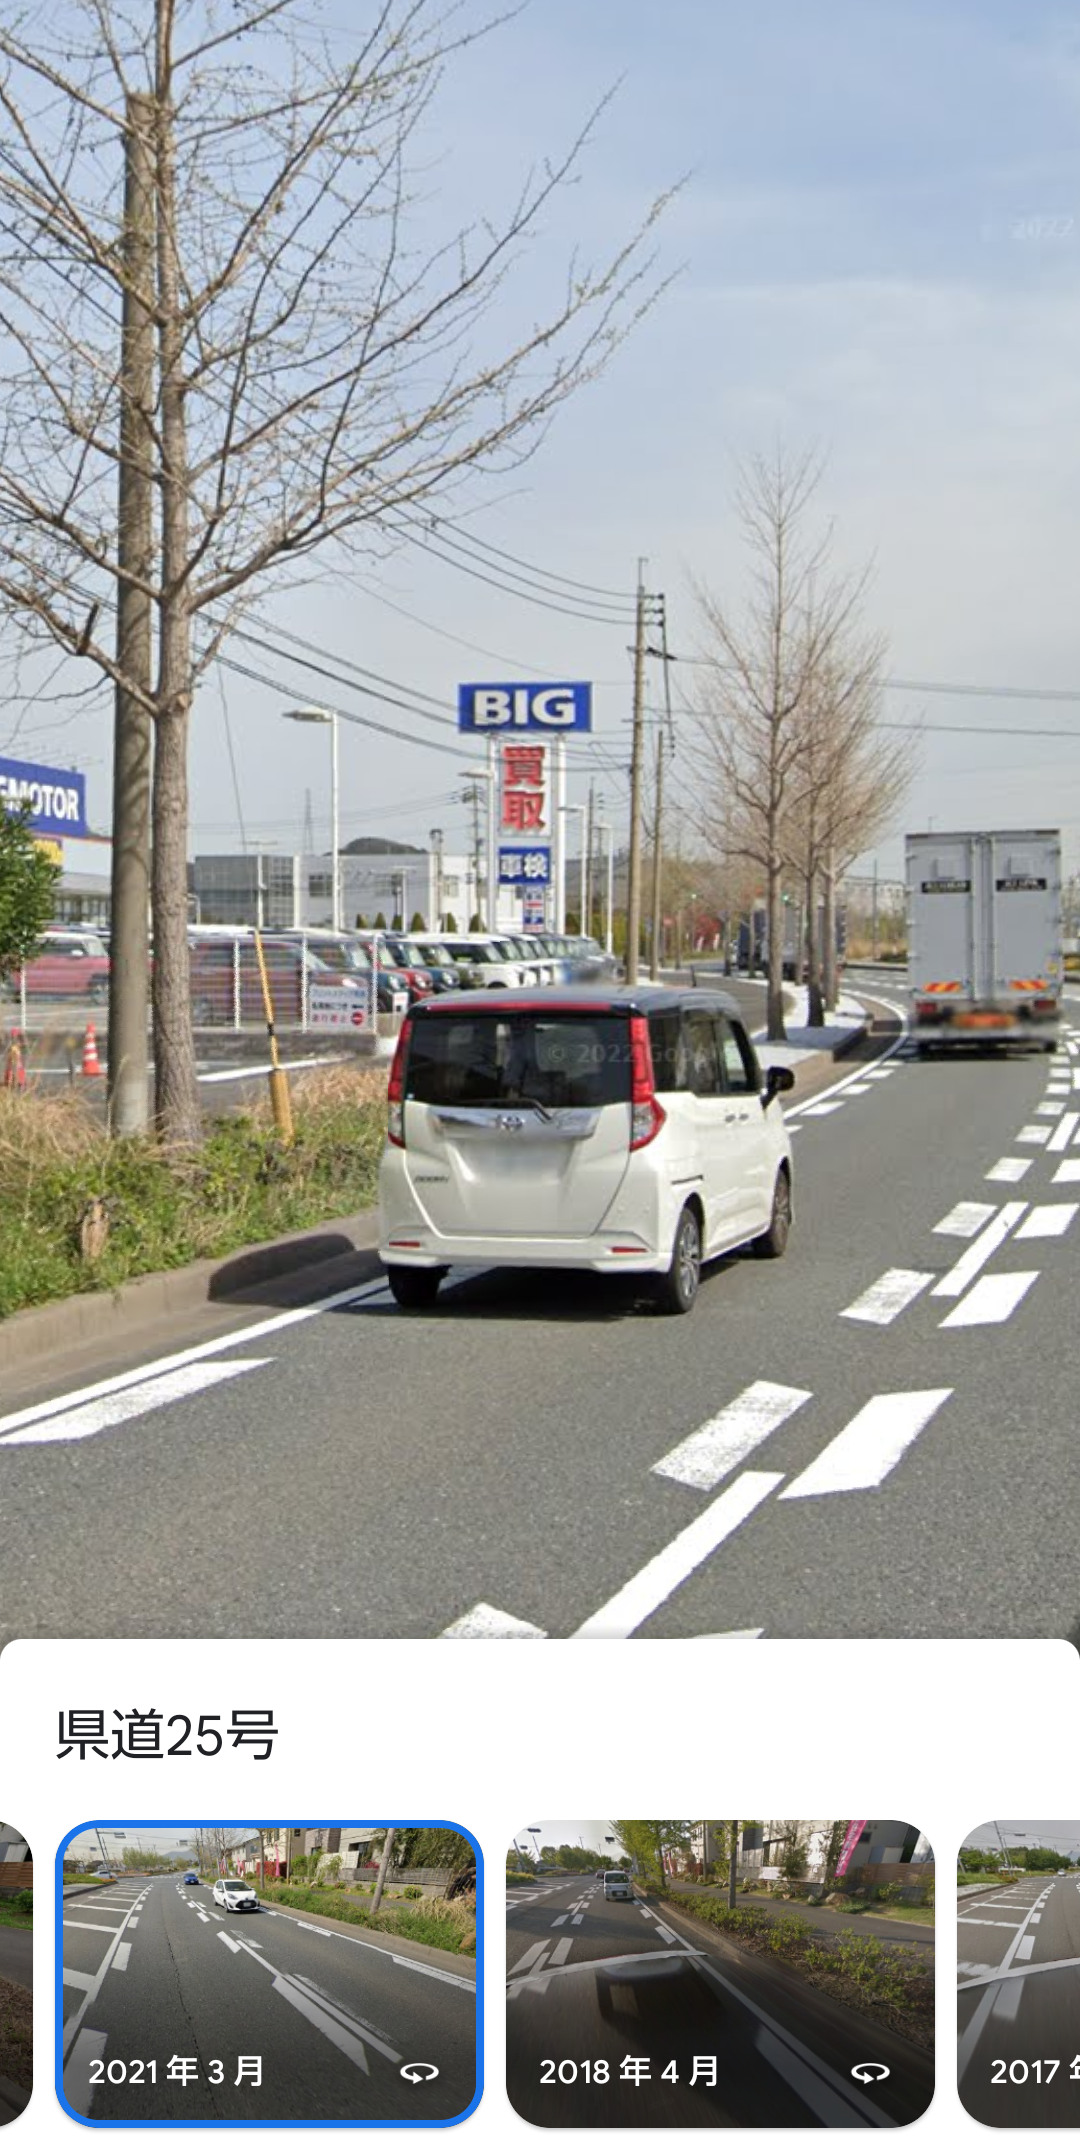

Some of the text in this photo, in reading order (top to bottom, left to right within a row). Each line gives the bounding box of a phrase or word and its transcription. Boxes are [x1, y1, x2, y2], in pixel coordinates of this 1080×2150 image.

[474, 689, 576, 725] BIG
[503, 746, 545, 830] 買取
[501, 854, 548, 877] 車検
[57, 1708, 278, 1760] 県道25号
[90, 2055, 261, 2086] 2021 年 3 月
[541, 2055, 716, 2086] 2018 年 4 月
[992, 2060, 1060, 2083] 2017
